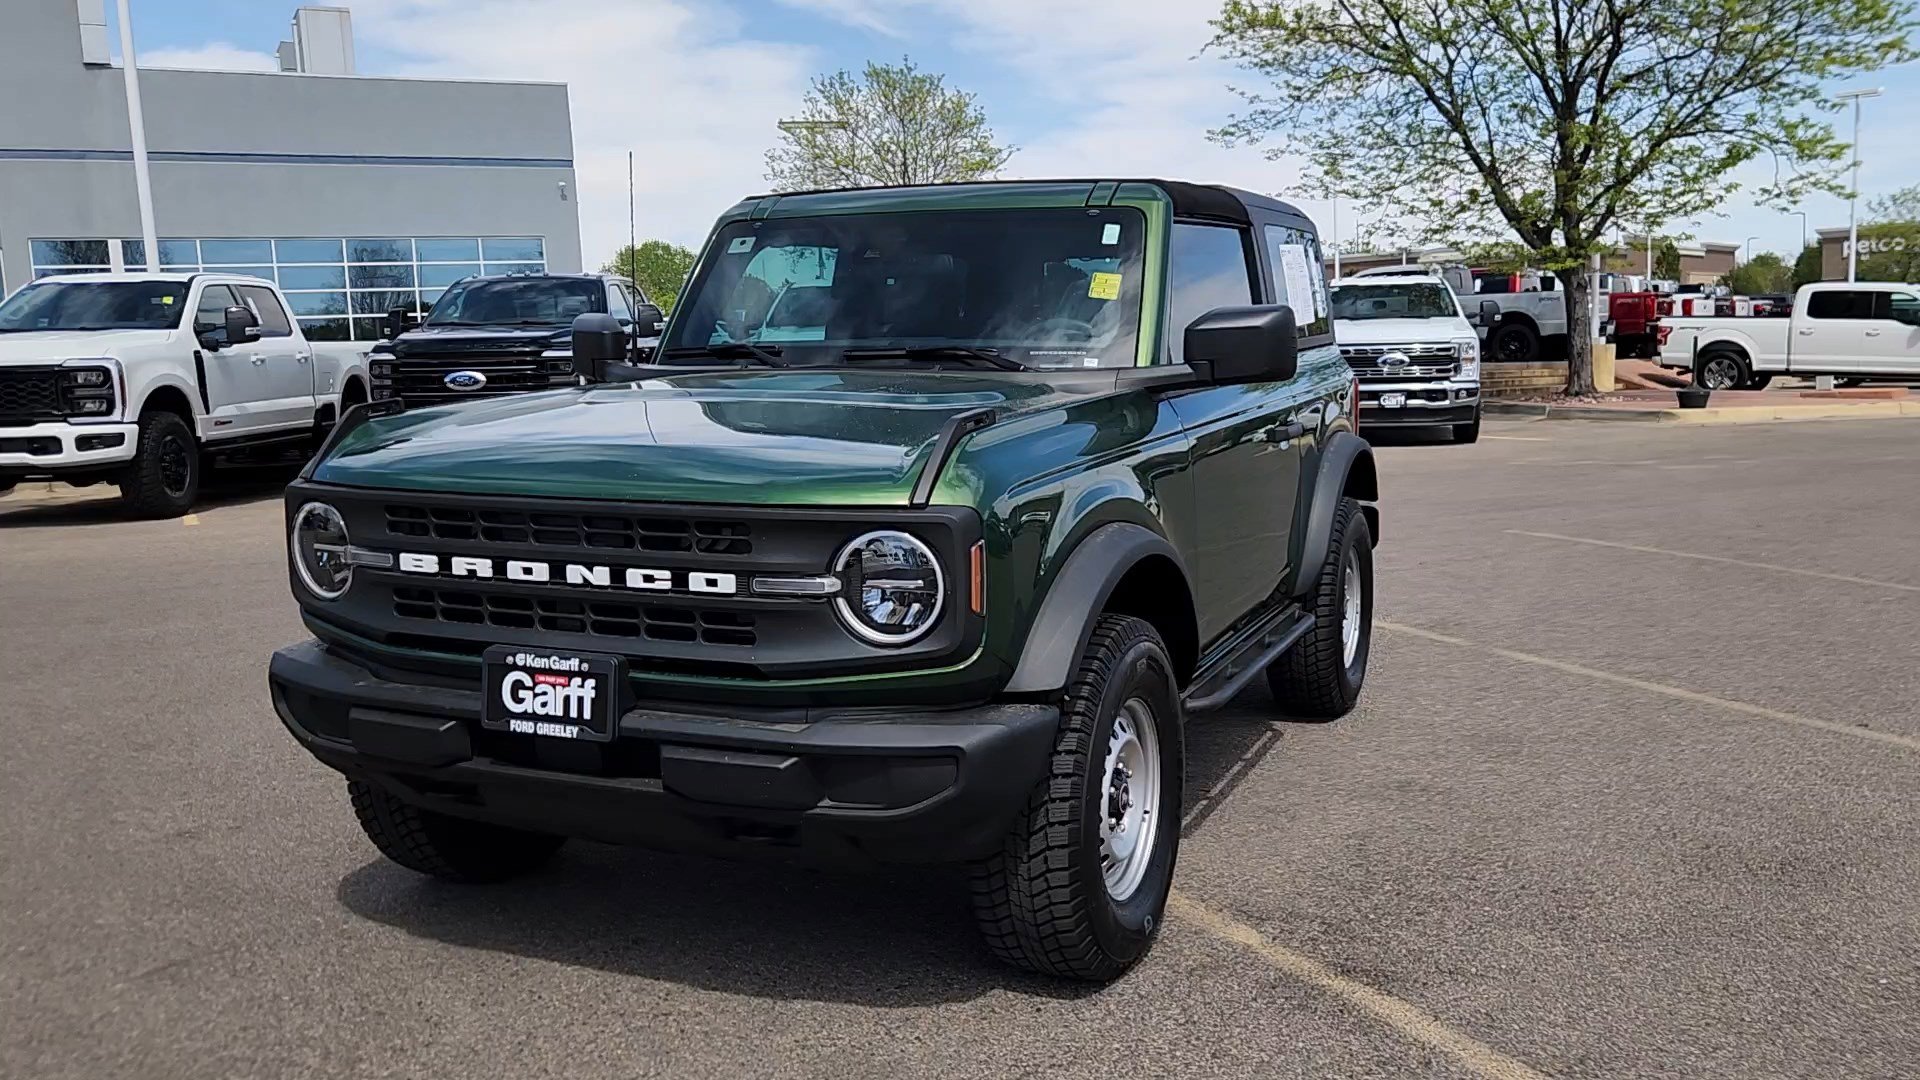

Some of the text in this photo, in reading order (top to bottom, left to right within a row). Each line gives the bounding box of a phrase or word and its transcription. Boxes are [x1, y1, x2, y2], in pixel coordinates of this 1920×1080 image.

[399, 552, 736, 594] BRONCO
[526, 654, 549, 669] Ken
[549, 656, 580, 671] Garff
[501, 670, 596, 720] Garff
[509, 719, 579, 739] FORD GREELEY
